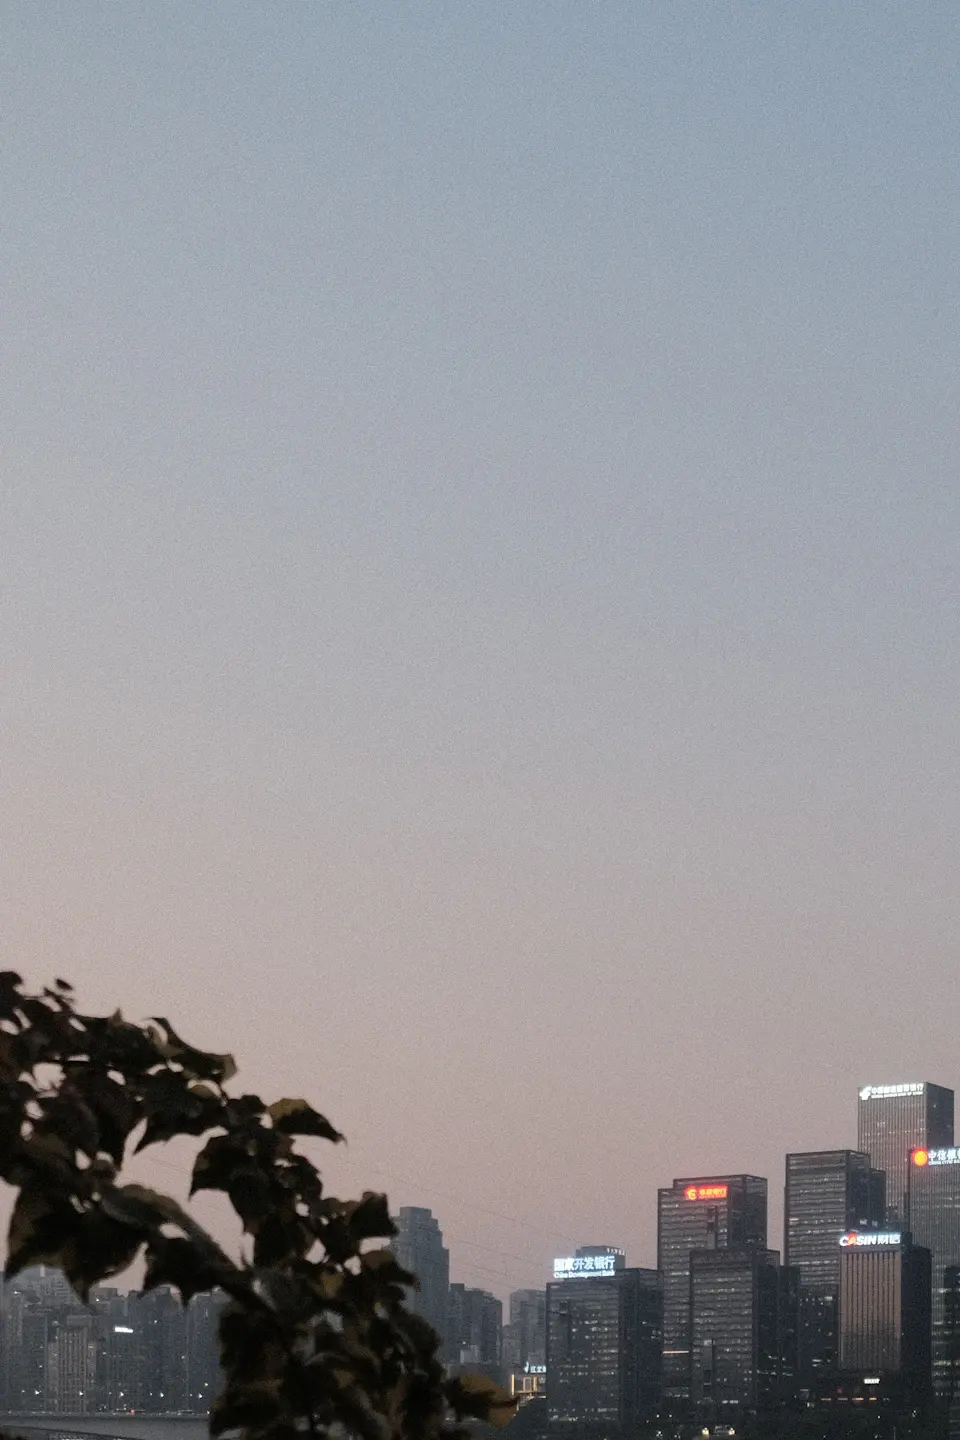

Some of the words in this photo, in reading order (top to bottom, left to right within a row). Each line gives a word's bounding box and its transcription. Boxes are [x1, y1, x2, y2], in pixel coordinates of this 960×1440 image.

[839, 1232, 876, 1246] CASIN
[554, 1256, 615, 1271] 国家开发银行
